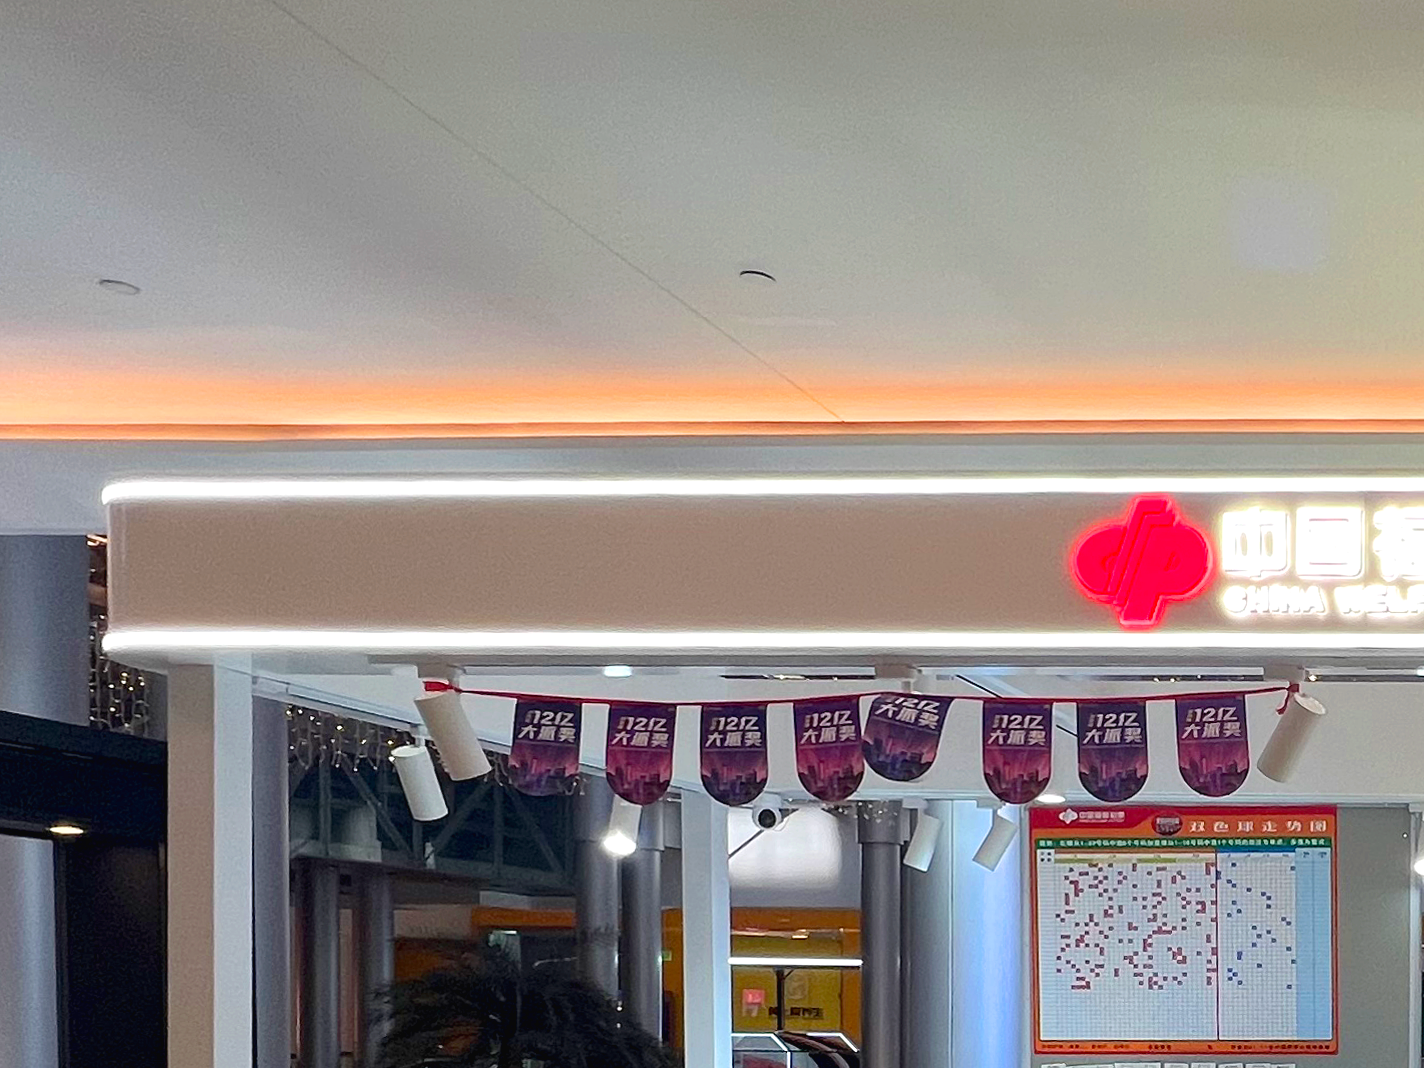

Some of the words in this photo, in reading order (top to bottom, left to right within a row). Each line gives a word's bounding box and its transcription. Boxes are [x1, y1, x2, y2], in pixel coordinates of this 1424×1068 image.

[1223, 585, 1327, 617] CHINA
[1189, 820, 1327, 833] 双色球走势图
